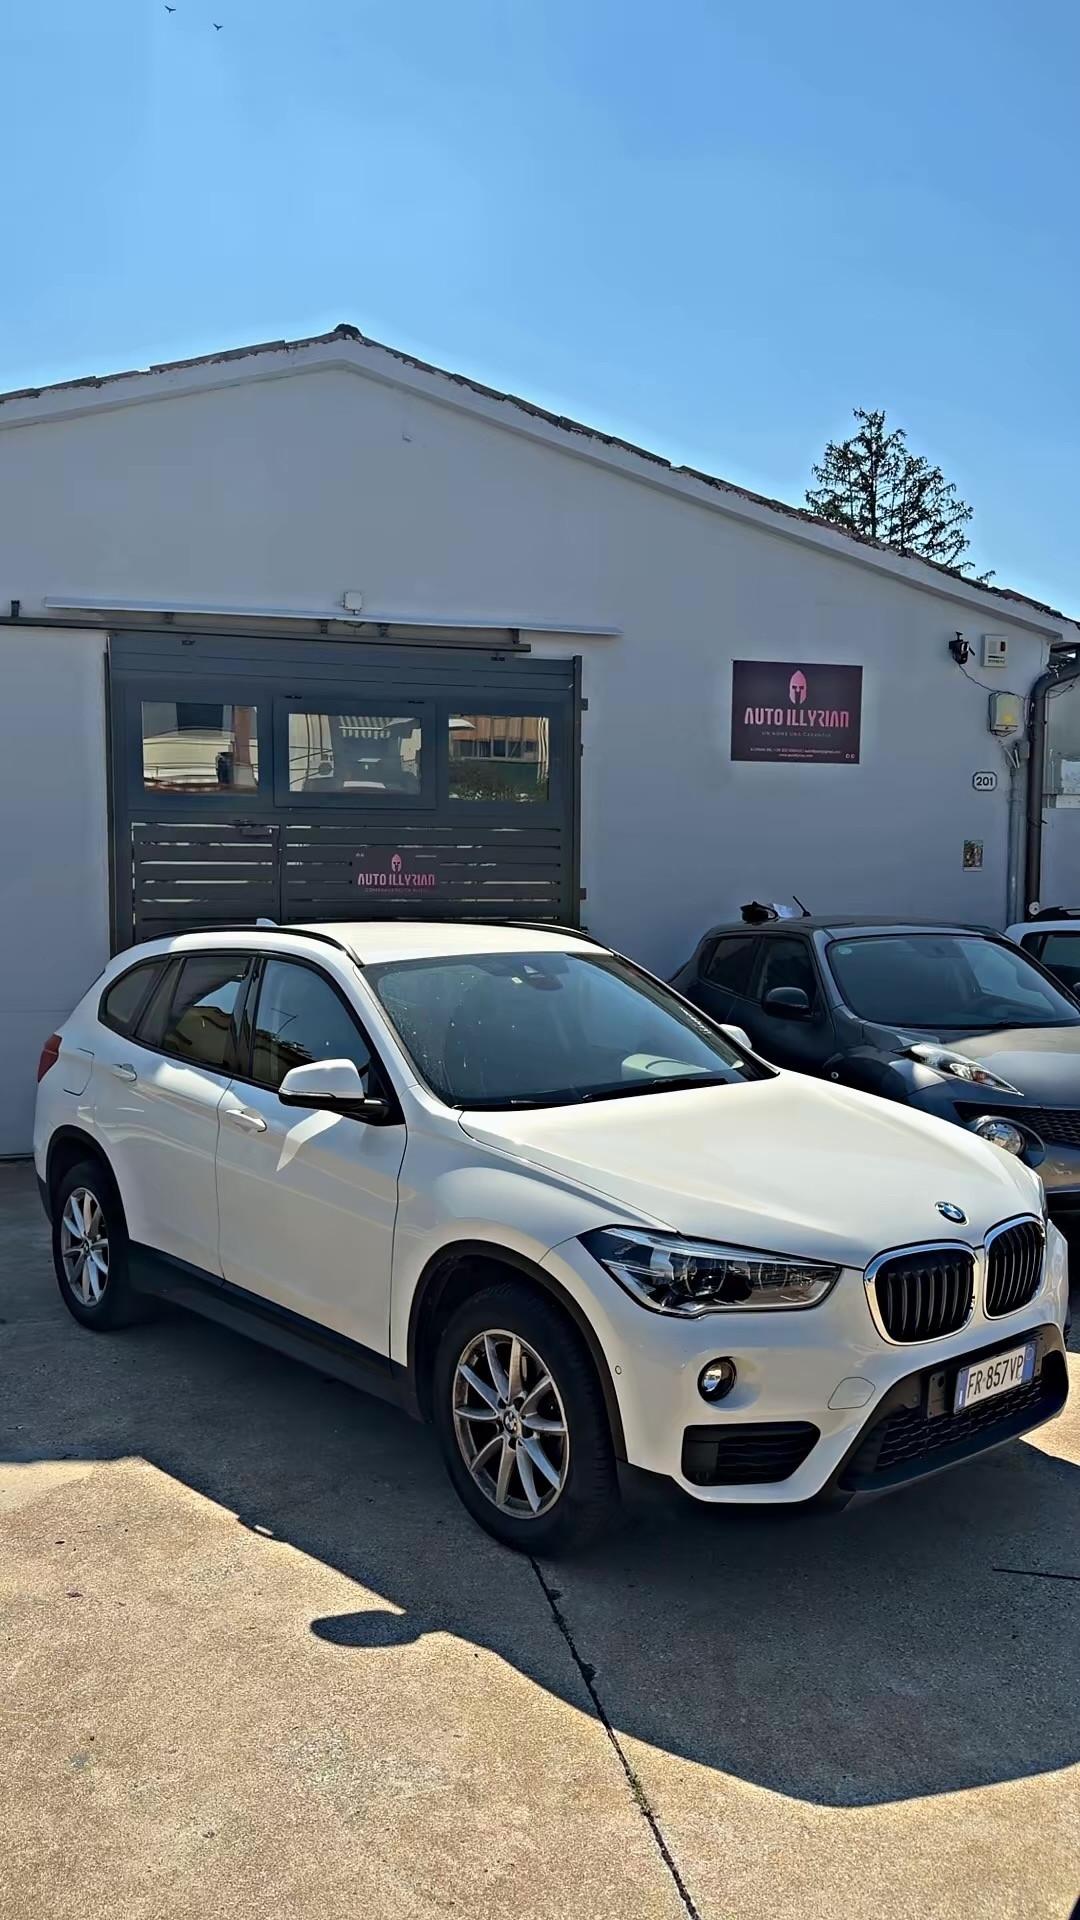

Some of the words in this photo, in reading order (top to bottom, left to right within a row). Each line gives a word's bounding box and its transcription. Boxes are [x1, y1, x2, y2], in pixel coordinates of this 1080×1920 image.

[744, 707, 783, 726] AUTO
[786, 709, 849, 728] ILLYRIAN
[976, 776, 993, 786] 201
[357, 873, 386, 886] AUTO
[389, 873, 435, 886] ILLYRIAN
[967, 1370, 983, 1398] FR
[986, 1355, 1024, 1390] 857VP
